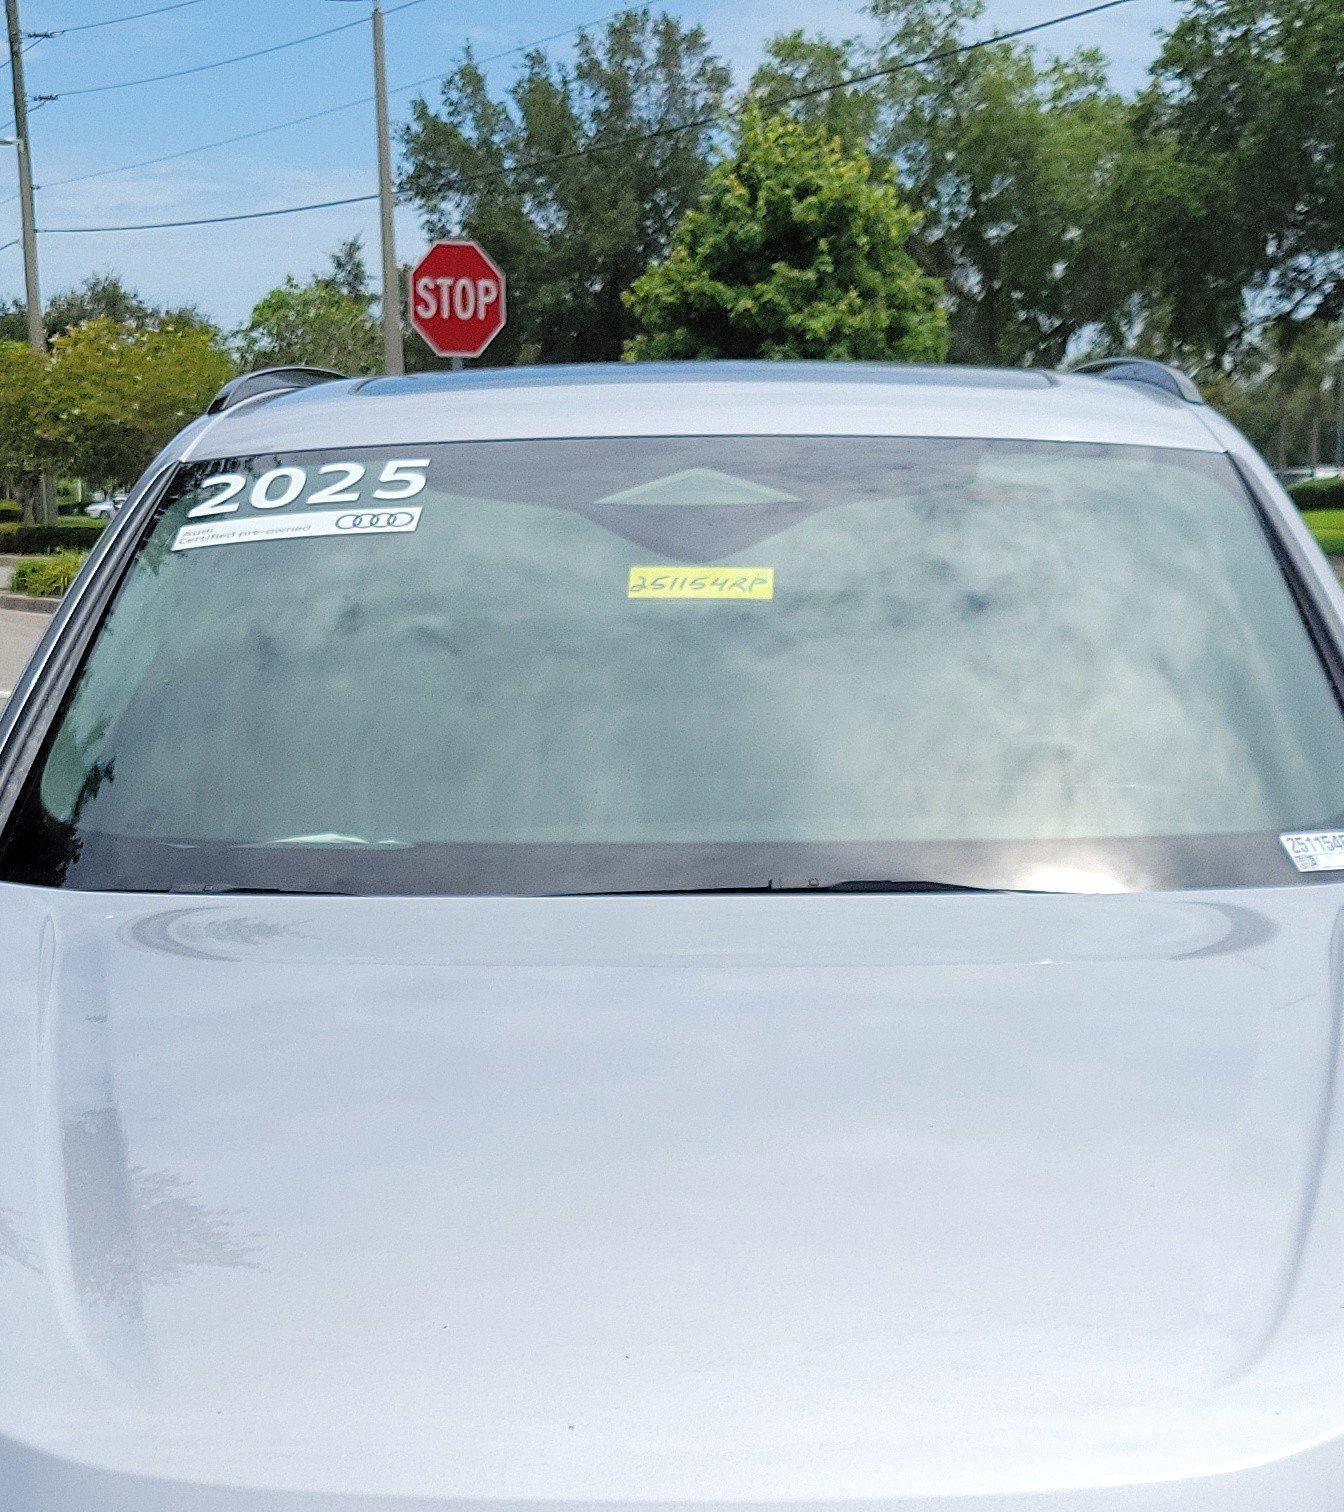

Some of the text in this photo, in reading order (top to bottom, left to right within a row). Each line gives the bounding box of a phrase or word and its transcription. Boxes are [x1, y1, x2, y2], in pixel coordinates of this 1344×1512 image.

[416, 276, 498, 320] STOP
[187, 457, 432, 518] 2025
[178, 531, 236, 545] Certified
[182, 527, 214, 537] Audi
[630, 575, 768, 593] 251154RP
